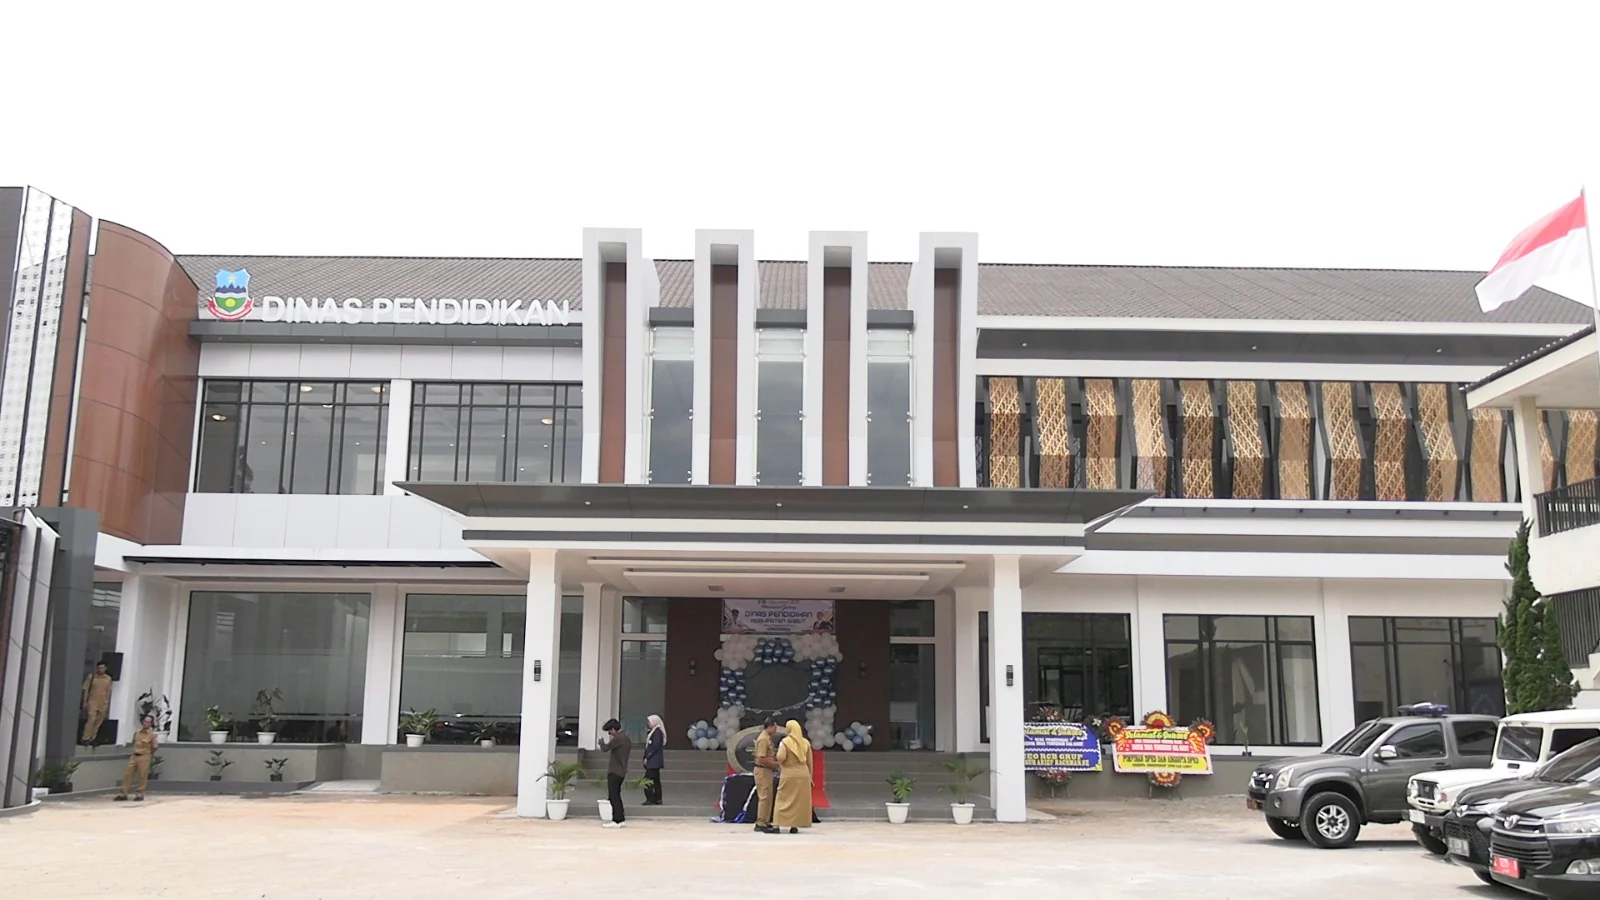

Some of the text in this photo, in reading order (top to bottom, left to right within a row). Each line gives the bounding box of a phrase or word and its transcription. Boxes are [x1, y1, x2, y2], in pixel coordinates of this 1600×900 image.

[261, 295, 570, 327] DINAS PENDIDIKAN
[744, 610, 813, 618] DINAS PENDIDIKAN
